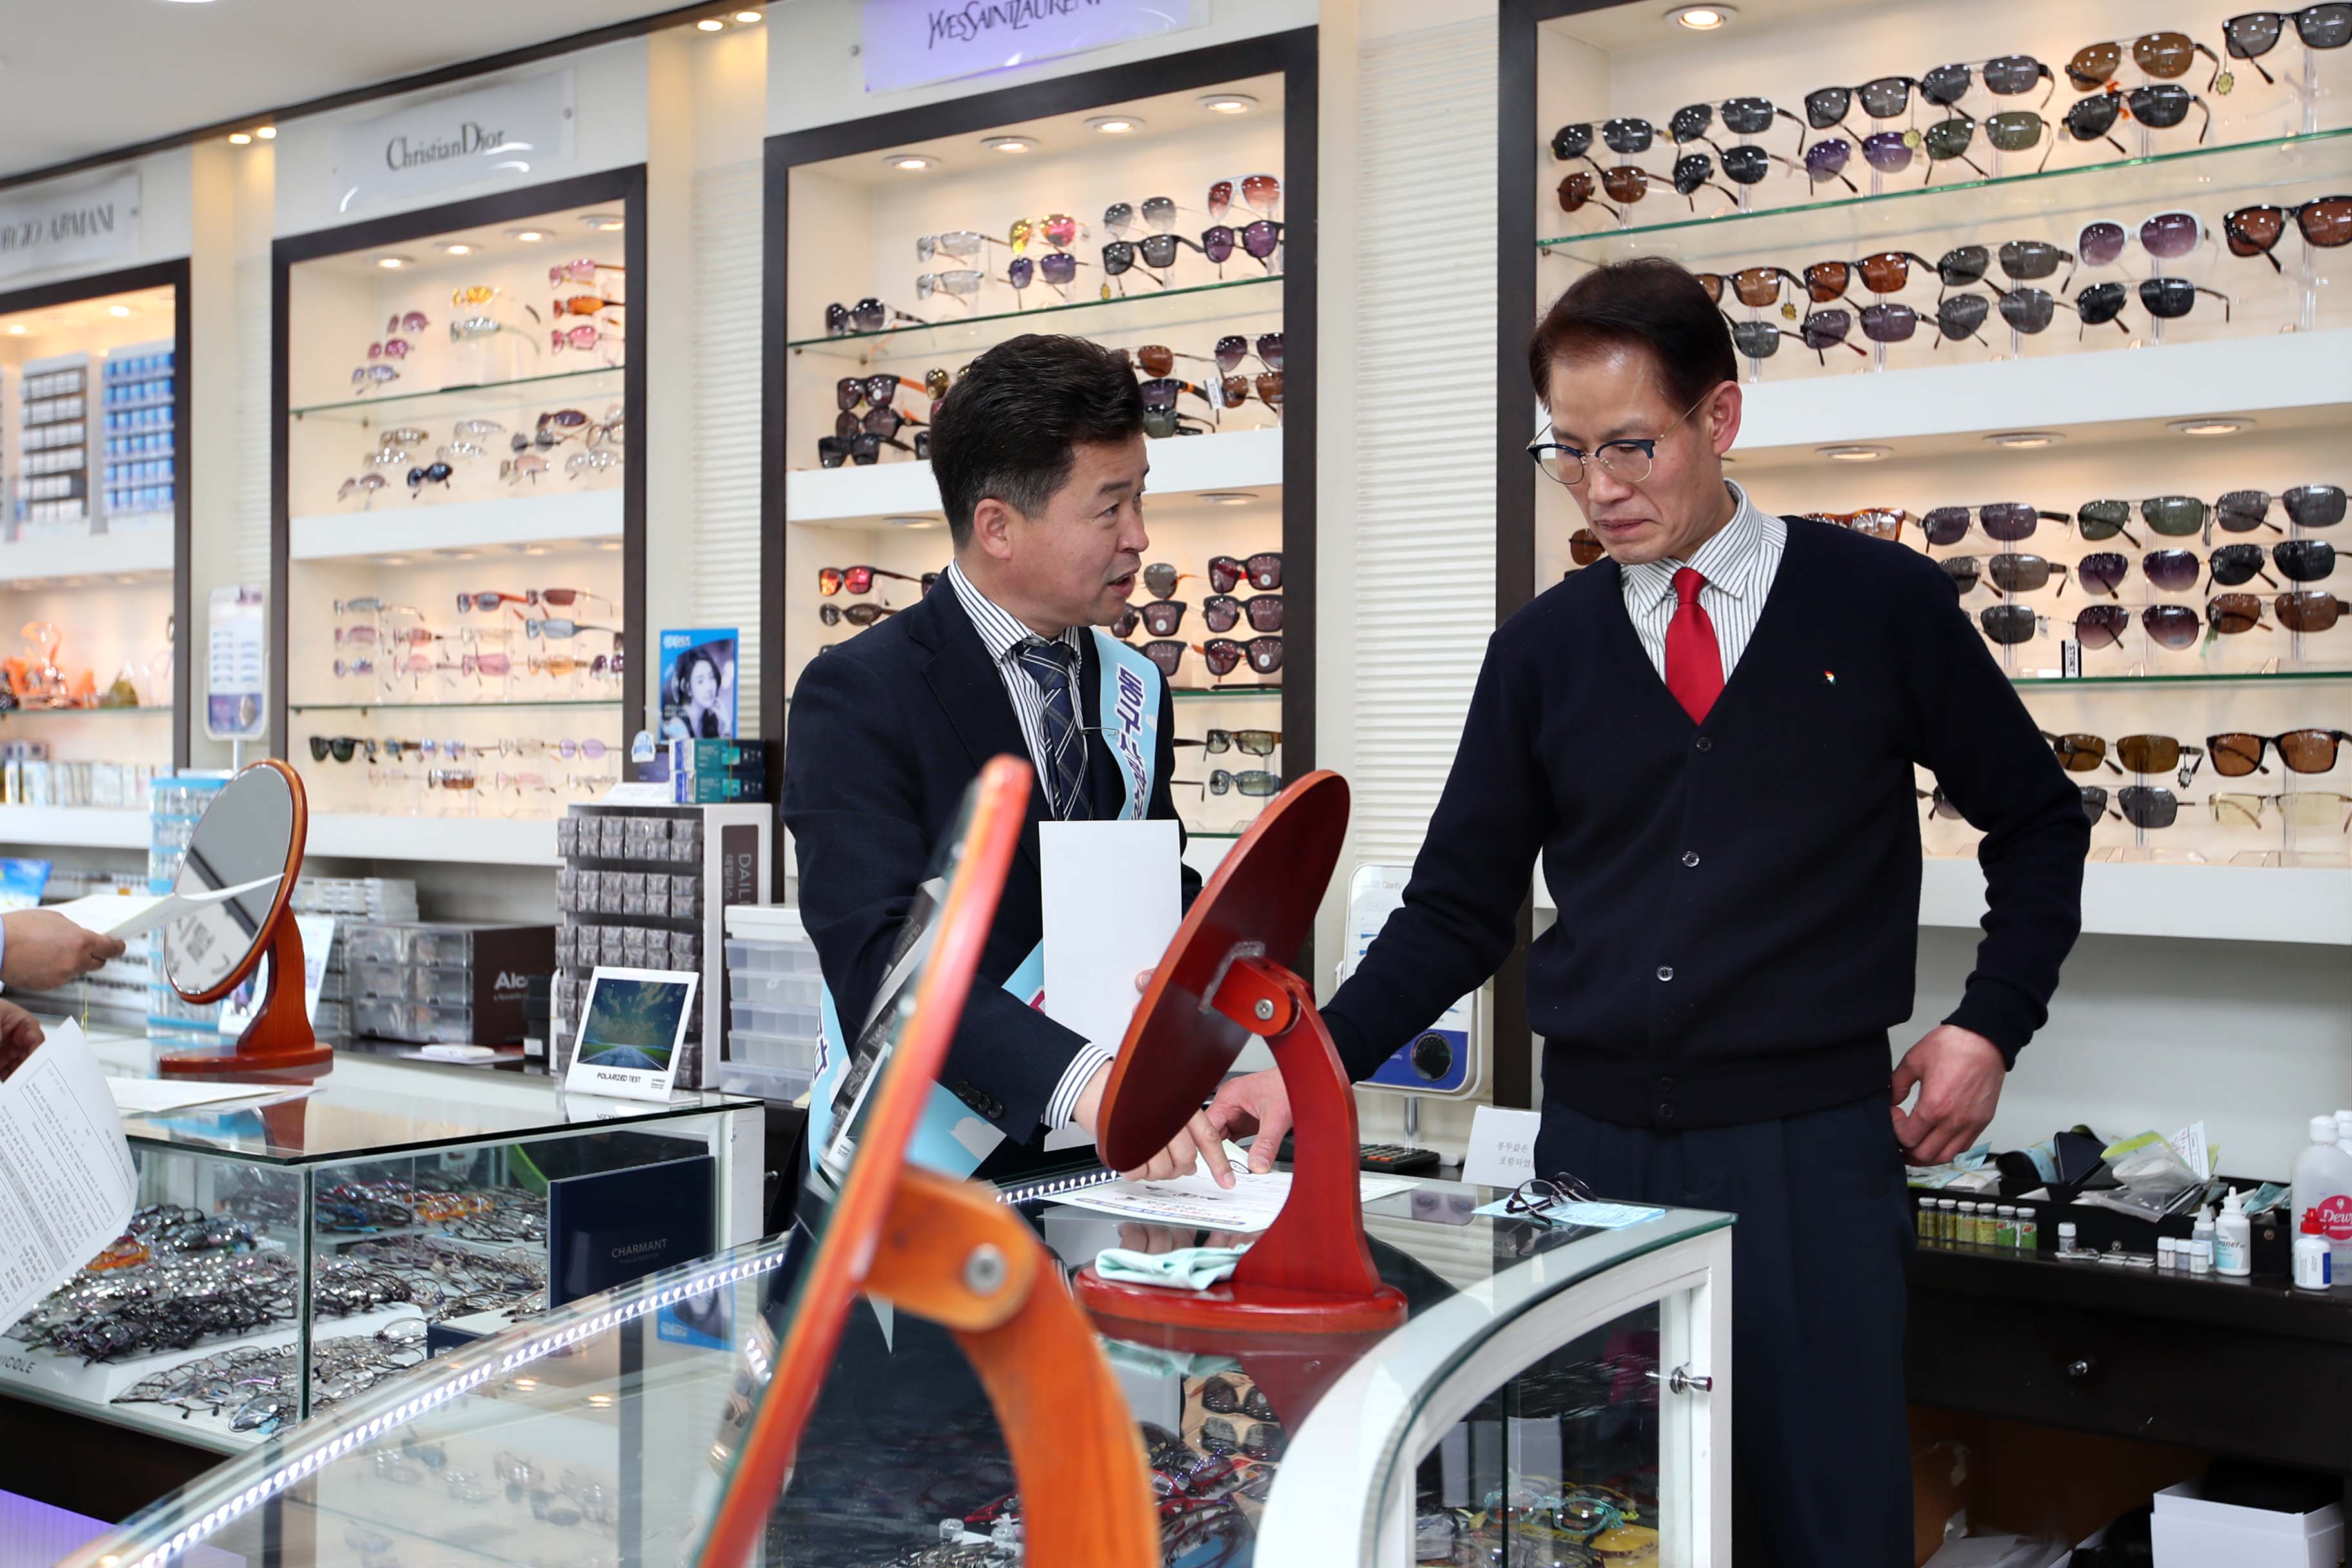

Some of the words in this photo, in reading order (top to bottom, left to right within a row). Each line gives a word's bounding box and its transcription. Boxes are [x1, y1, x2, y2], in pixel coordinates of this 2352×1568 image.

[51, 203, 114, 242] ARMANI
[494, 970, 527, 990] Alc
[596, 1072, 628, 1083] POLARIZED
[628, 1075, 642, 1084] TEST
[1498, 1156, 1534, 1169] 포함되었
[611, 1238, 668, 1259] CHARMANT
